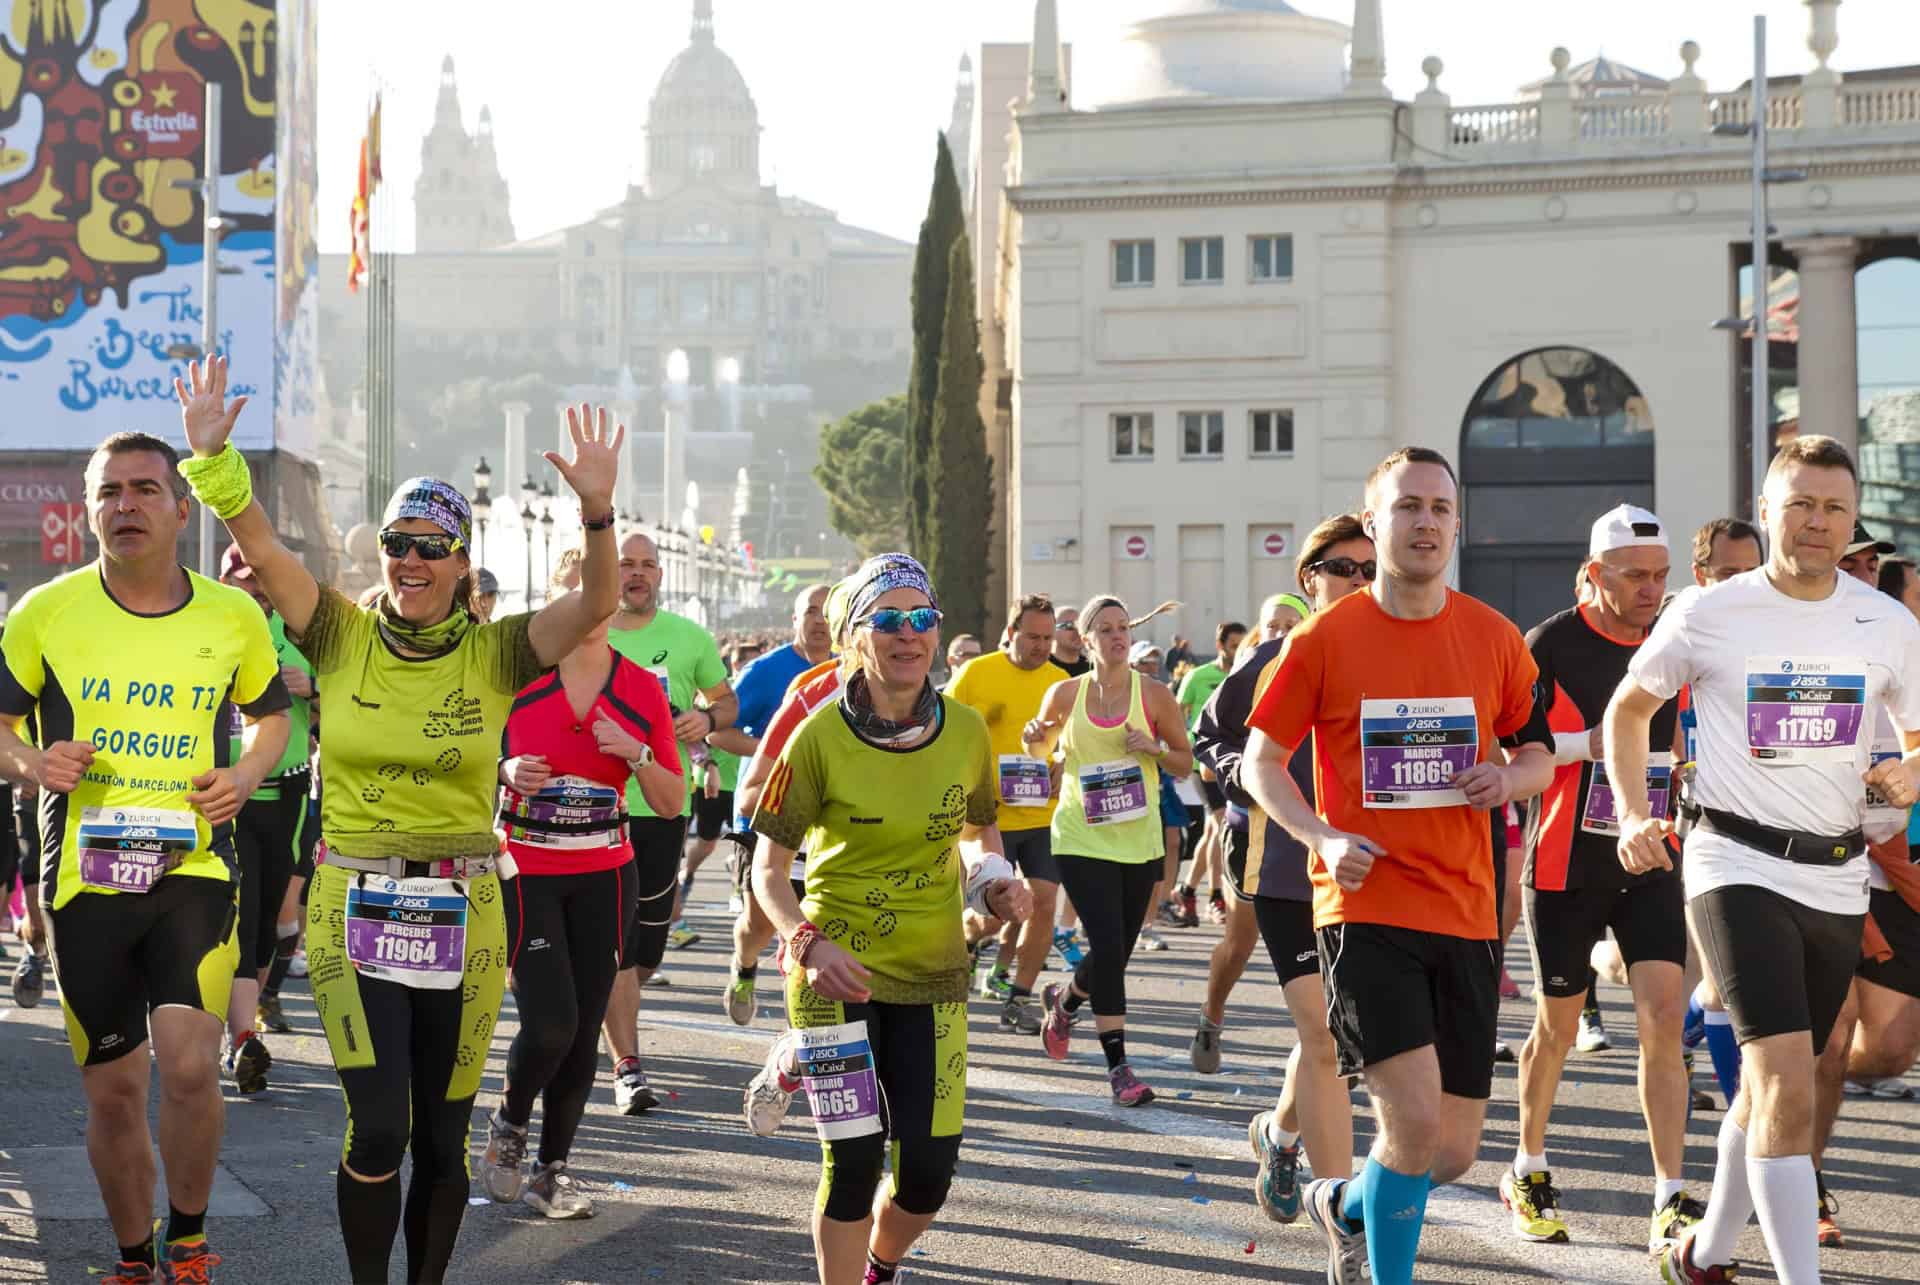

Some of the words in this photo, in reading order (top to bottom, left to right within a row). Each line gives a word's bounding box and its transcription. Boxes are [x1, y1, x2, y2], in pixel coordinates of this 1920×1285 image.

[139, 283, 203, 324] The
[1797, 664, 1830, 672] ZURICH
[1800, 677, 1828, 686] asics
[81, 676, 111, 703] VA
[126, 681, 174, 709] POR
[191, 686, 216, 710] TI
[1412, 705, 1446, 714] ZURICH
[1790, 705, 1826, 716] JOHNNY
[1416, 720, 1442, 729] asics
[1776, 718, 1837, 741] 11769
[92, 727, 199, 760] GORGUE!
[1403, 748, 1443, 760] MARCUS
[1392, 760, 1454, 785] 11869
[129, 777, 188, 792] BARCELONA
[118, 853, 158, 864] ANTONIO
[400, 883, 434, 894] ZURICH
[402, 898, 430, 908] asics
[384, 923, 432, 938] MERCEDES
[374, 935, 437, 964] 11964
